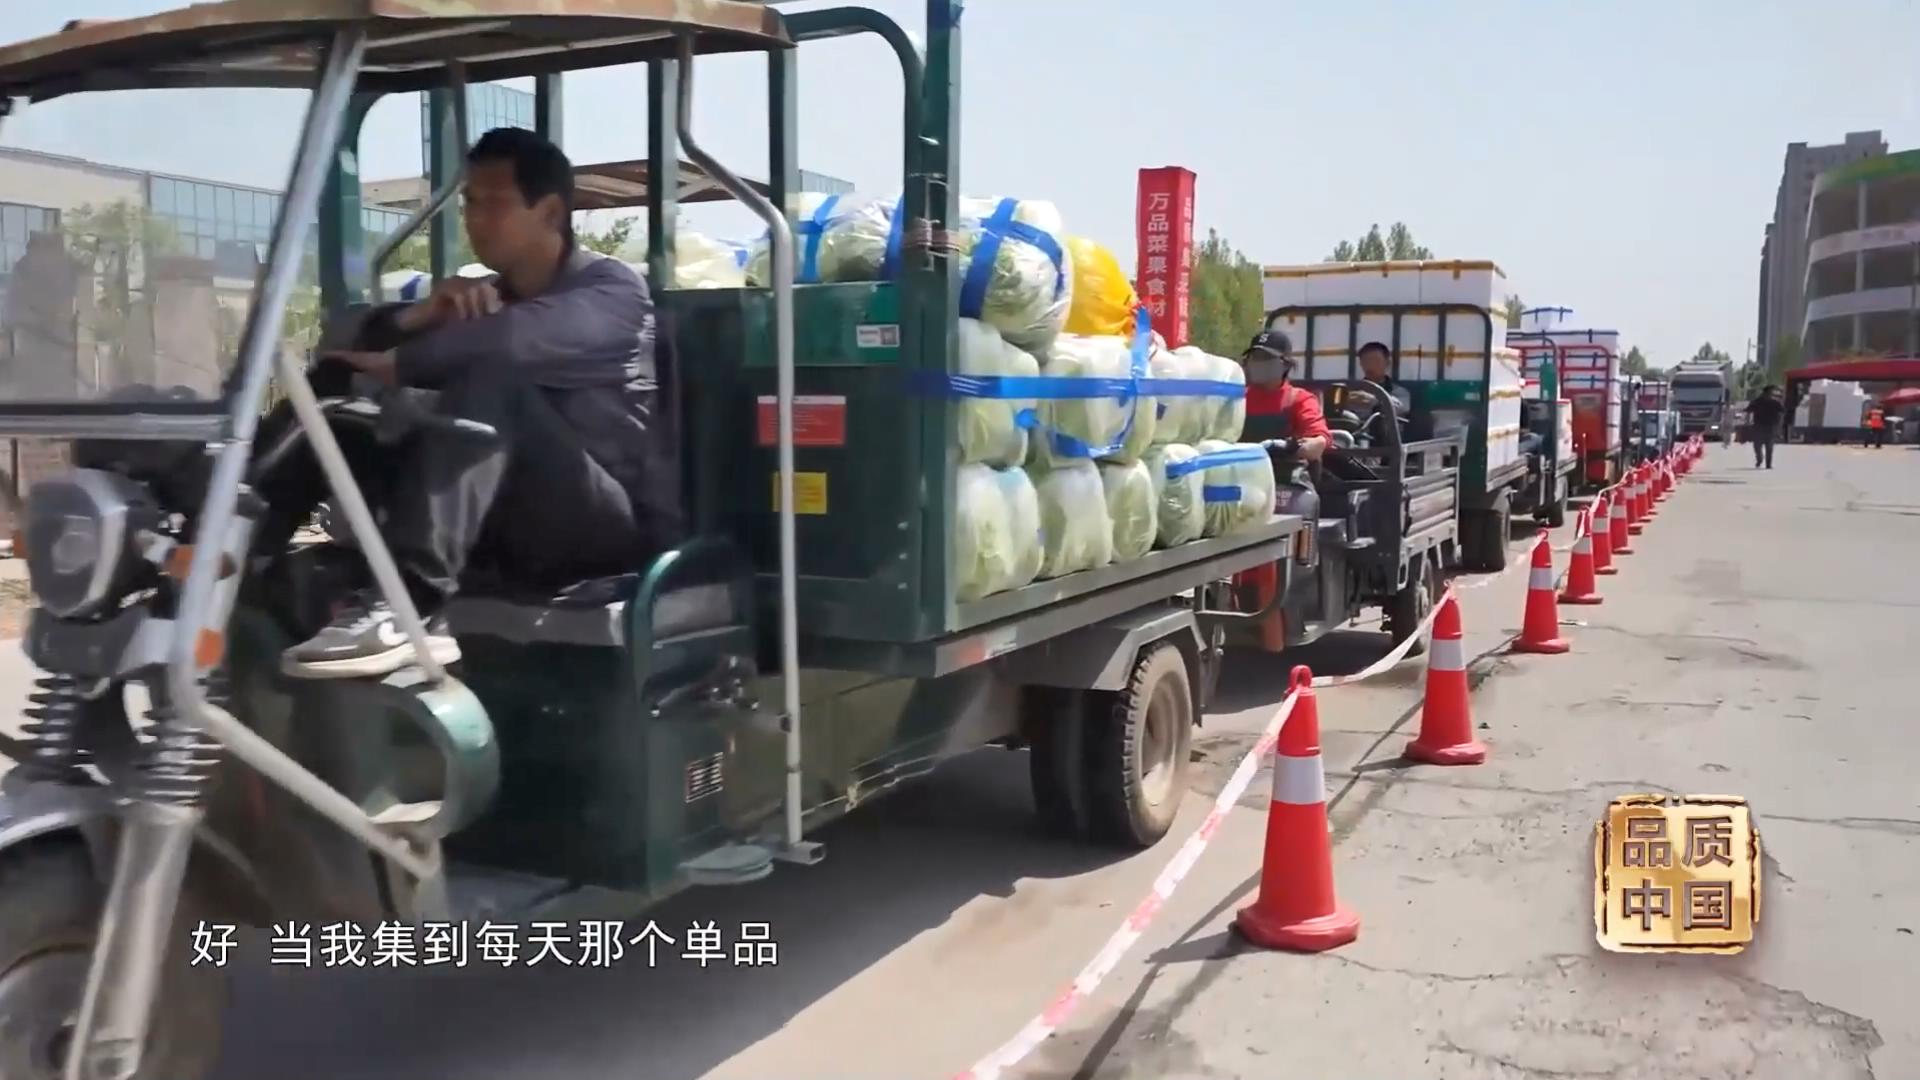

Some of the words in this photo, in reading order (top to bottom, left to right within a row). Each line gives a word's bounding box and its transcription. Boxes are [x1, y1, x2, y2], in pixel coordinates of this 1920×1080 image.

[1146, 192, 1170, 317] 万品菜果食材
